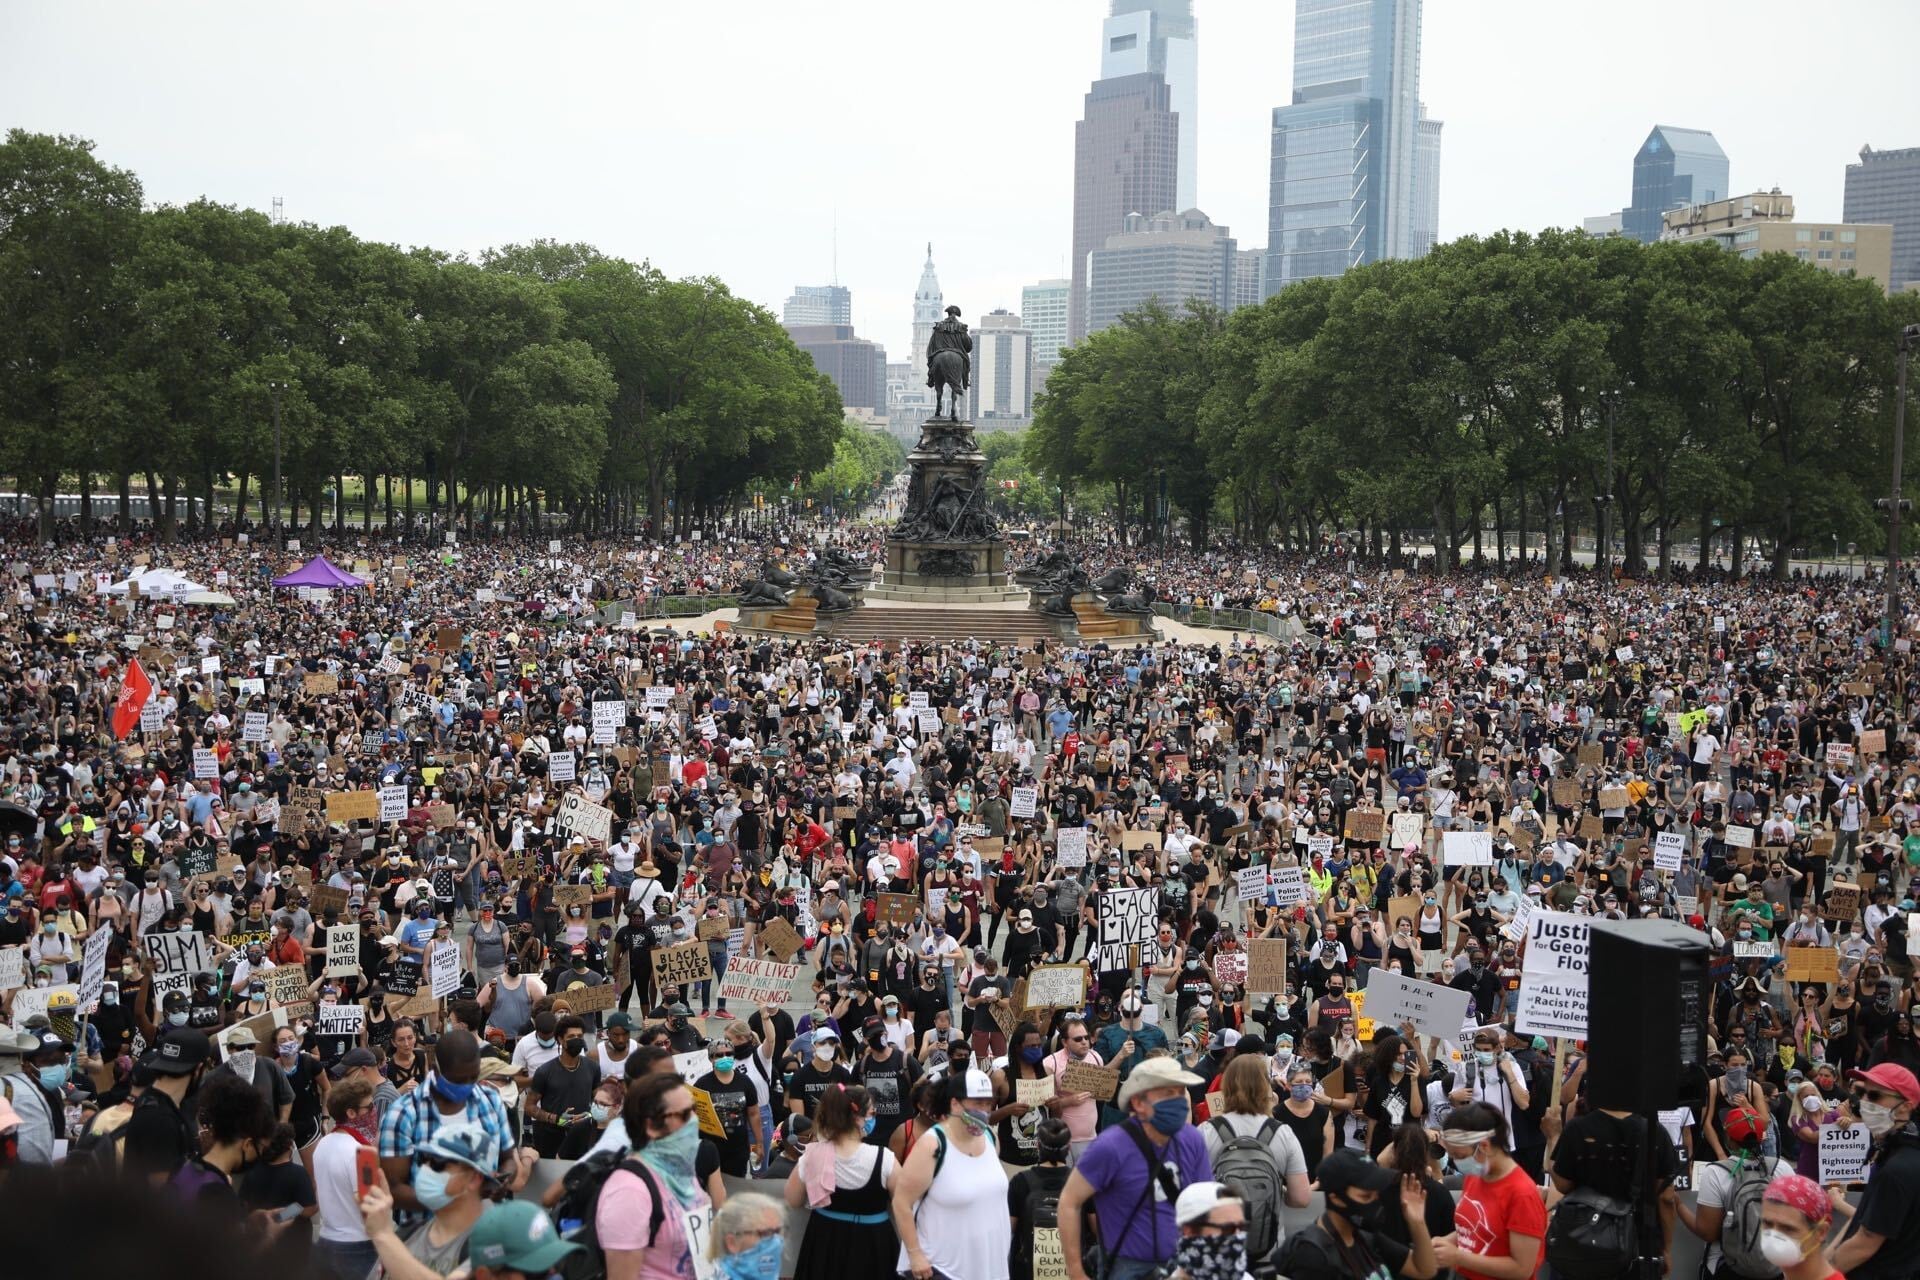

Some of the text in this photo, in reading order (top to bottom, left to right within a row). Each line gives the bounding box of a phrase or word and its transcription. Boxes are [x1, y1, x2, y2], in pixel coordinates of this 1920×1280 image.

[404, 689, 432, 704] BLACK
[364, 736, 384, 744] LIVES
[384, 804, 404, 812] Police
[563, 796, 609, 820] NO JUSTICE
[557, 812, 608, 838] NO PEACE
[1660, 835, 1680, 844] STOP
[184, 852, 213, 864] JUSTICE!
[190, 849, 203, 857] NO
[1242, 869, 1262, 879] STOP
[1273, 875, 1300, 885] Racist
[1277, 886, 1301, 895] Police
[1833, 887, 1857, 898] BLACK
[1100, 887, 1158, 919] BLACK
[1278, 893, 1302, 901] Terror!
[1532, 918, 1588, 940] Justi
[332, 931, 355, 943] BLACK
[333, 943, 355, 954] LIVES
[1534, 938, 1589, 956] for Geor
[146, 934, 202, 974] BLM
[432, 947, 457, 965] Justice
[660, 947, 699, 965] BLACK
[1099, 939, 1158, 972] MATTER
[328, 955, 357, 967] MATTER
[668, 956, 709, 973] LIVES
[1557, 955, 1589, 975] Floy
[394, 963, 412, 973] White
[727, 957, 799, 979] BLACK LIVES
[256, 972, 273, 981] THE
[657, 967, 708, 985] MATTER
[153, 973, 191, 995] FORGET
[387, 982, 417, 995] Violence
[719, 982, 746, 997] WHITE
[1540, 985, 1562, 996] ALL
[1564, 987, 1586, 999] Vict
[1534, 996, 1569, 1008] Racist
[321, 1007, 344, 1018] BLACK
[344, 1007, 362, 1017] LIVES
[1552, 1009, 1588, 1022] Violen
[319, 1017, 362, 1034] MATTER
[866, 1070, 897, 1079] Corrupted
[804, 1083, 815, 1092] THE
[1825, 1129, 1860, 1140] STOP
[1820, 1142, 1866, 1152] Repressing
[1825, 1166, 1862, 1176] Protest!
[1037, 1229, 1060, 1241] STO
[1034, 1242, 1064, 1255] KILLI
[1039, 1256, 1065, 1266] BLAC
[1036, 1268, 1069, 1278] PEOPL
